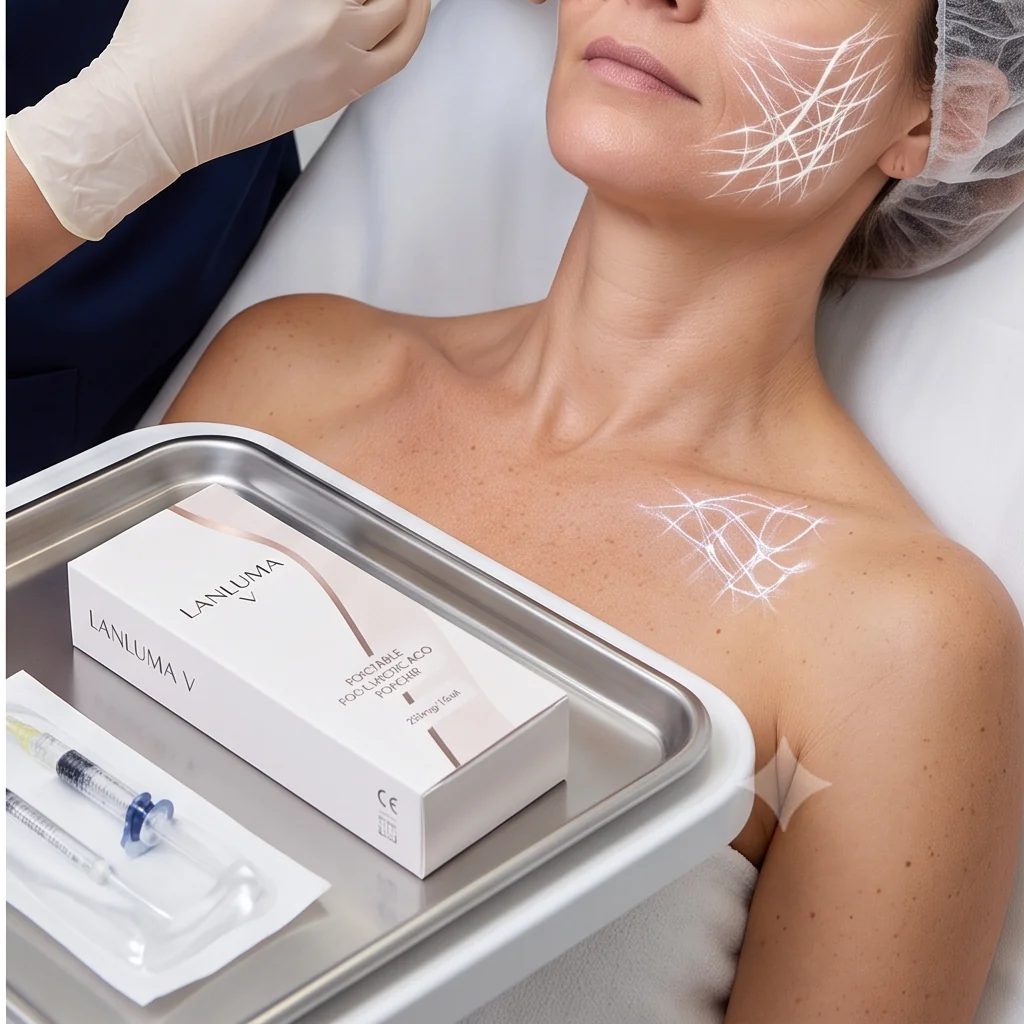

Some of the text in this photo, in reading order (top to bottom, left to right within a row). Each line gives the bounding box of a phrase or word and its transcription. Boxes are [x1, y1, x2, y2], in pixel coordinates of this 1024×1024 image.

[179, 559, 285, 619] LANLUMA
[238, 590, 257, 603] V
[89, 609, 196, 692] LANLUMA V
